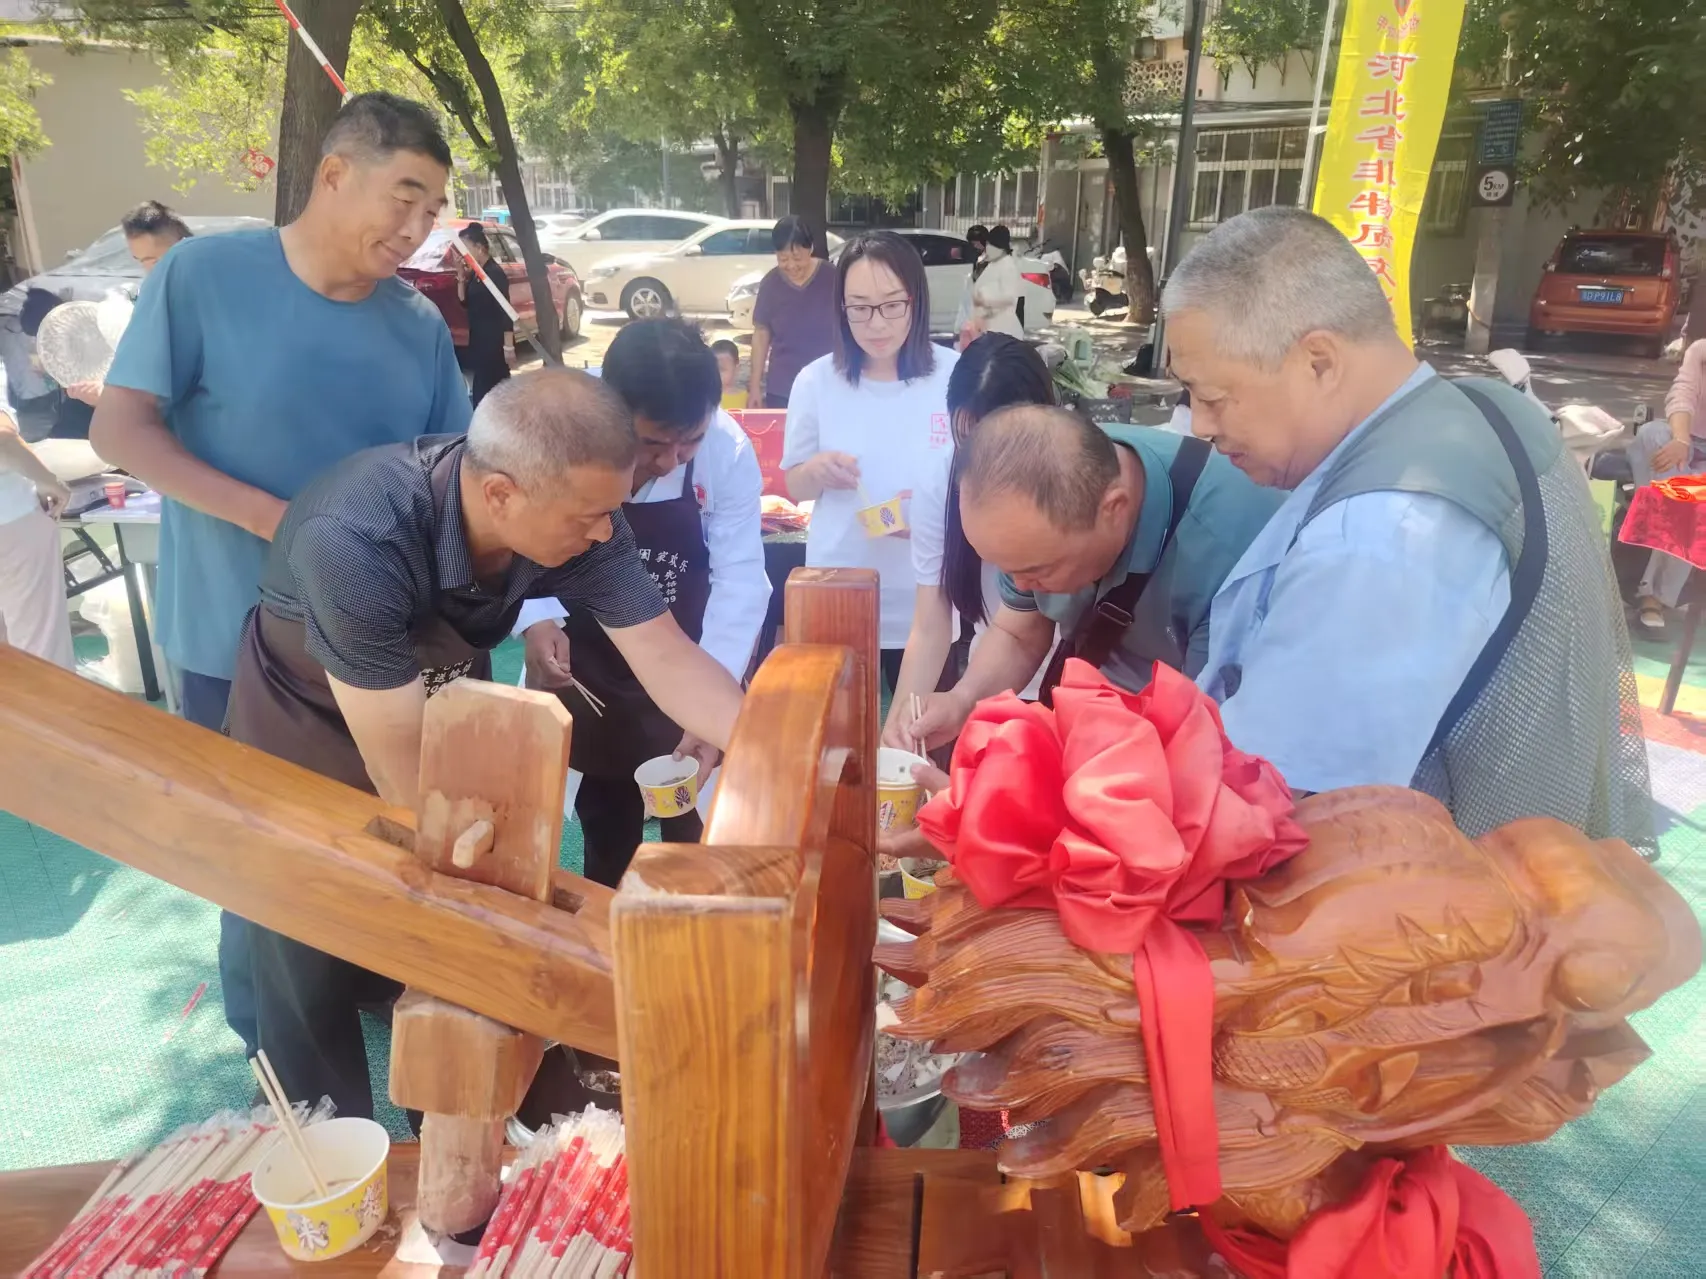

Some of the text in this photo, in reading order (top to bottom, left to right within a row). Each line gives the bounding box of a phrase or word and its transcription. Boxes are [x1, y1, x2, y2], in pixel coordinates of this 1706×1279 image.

[1348, 53, 1416, 302] 河北省非物质文
